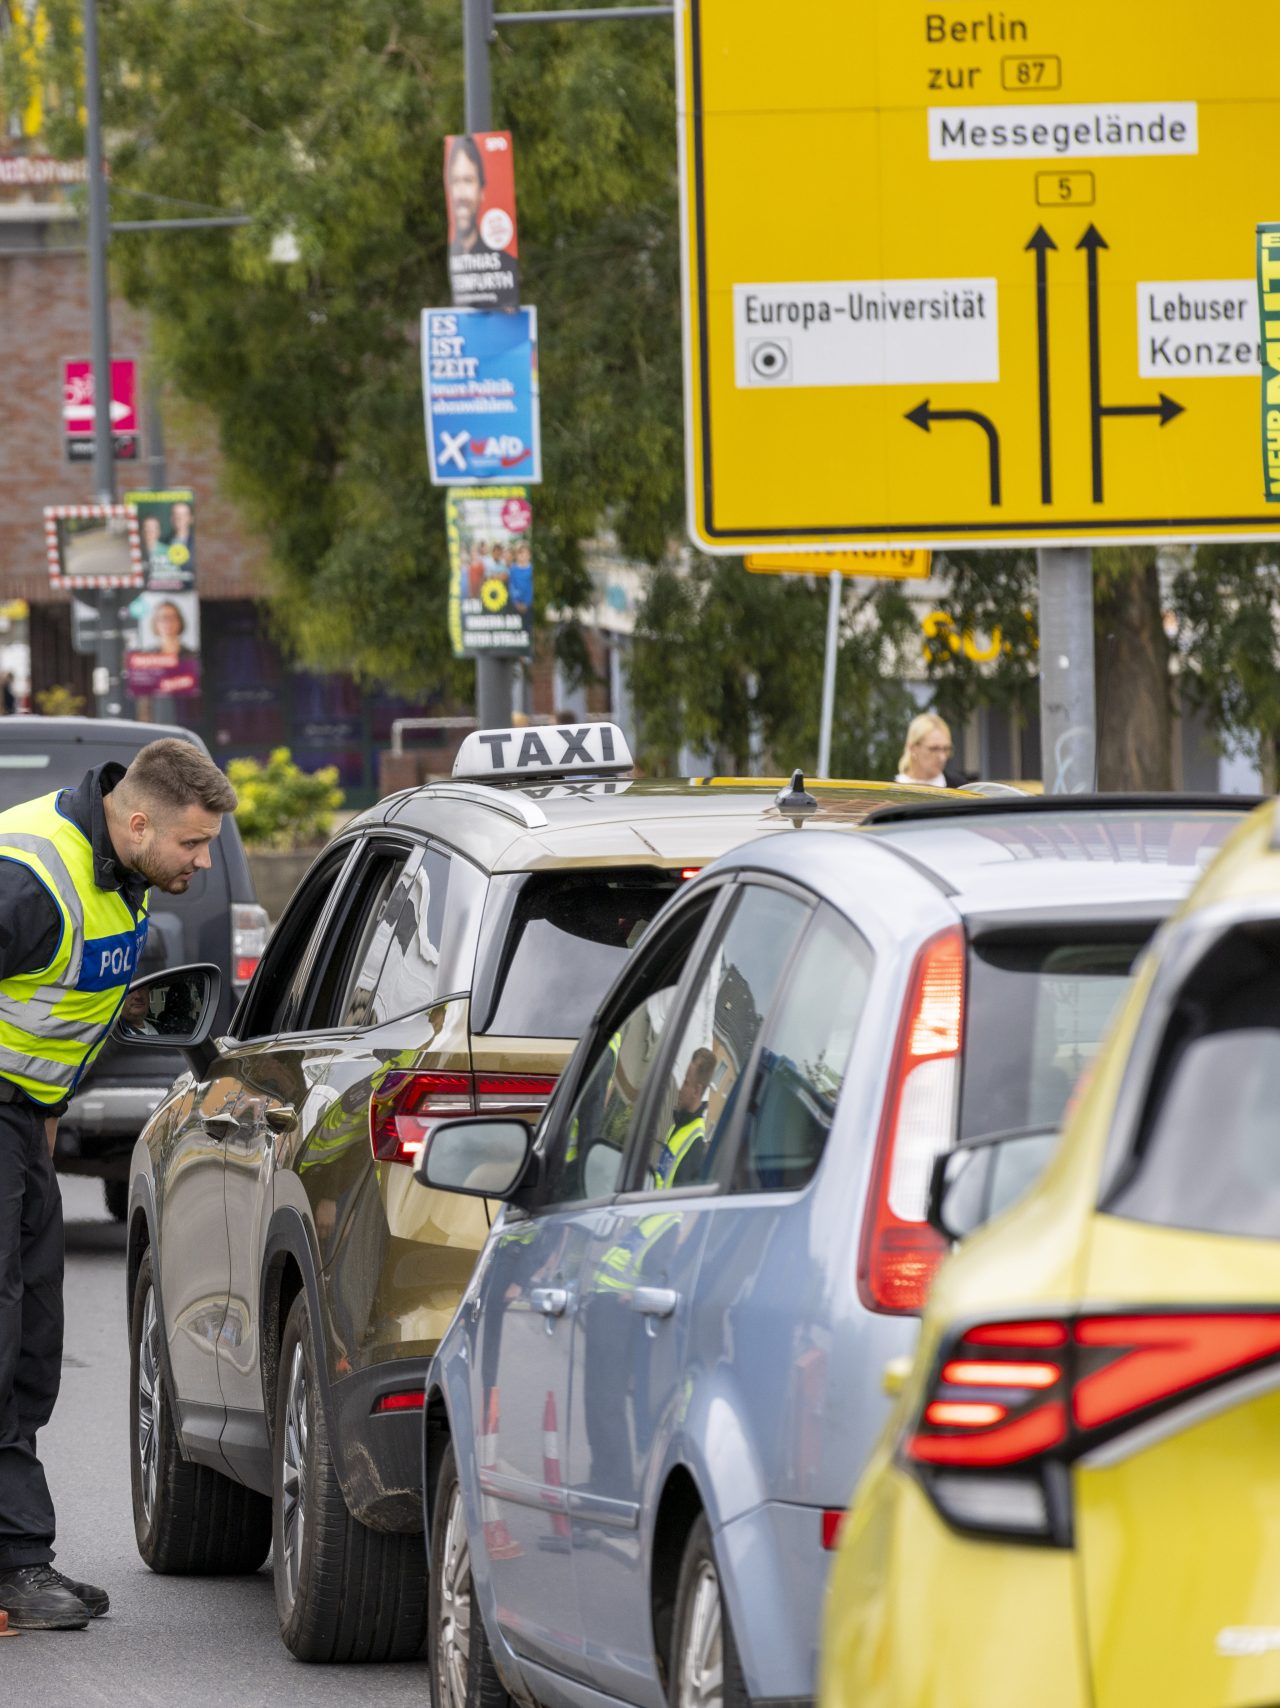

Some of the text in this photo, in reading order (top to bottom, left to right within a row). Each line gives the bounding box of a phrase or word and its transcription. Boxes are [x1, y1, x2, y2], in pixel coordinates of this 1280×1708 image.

[926, 13, 1028, 43] Berlin
[928, 62, 1046, 90] zur 87
[941, 113, 1187, 152] Messegelände
[1058, 177, 1072, 200] 5
[745, 290, 986, 330] Europa-Universität
[1149, 292, 1248, 322] Lebuser
[432, 315, 457, 335] ES
[432, 337, 464, 357] IST
[432, 358, 479, 379] ZEIT
[485, 436, 523, 457] AfD
[479, 727, 616, 769] TAXI
[100, 946, 132, 977] POL
